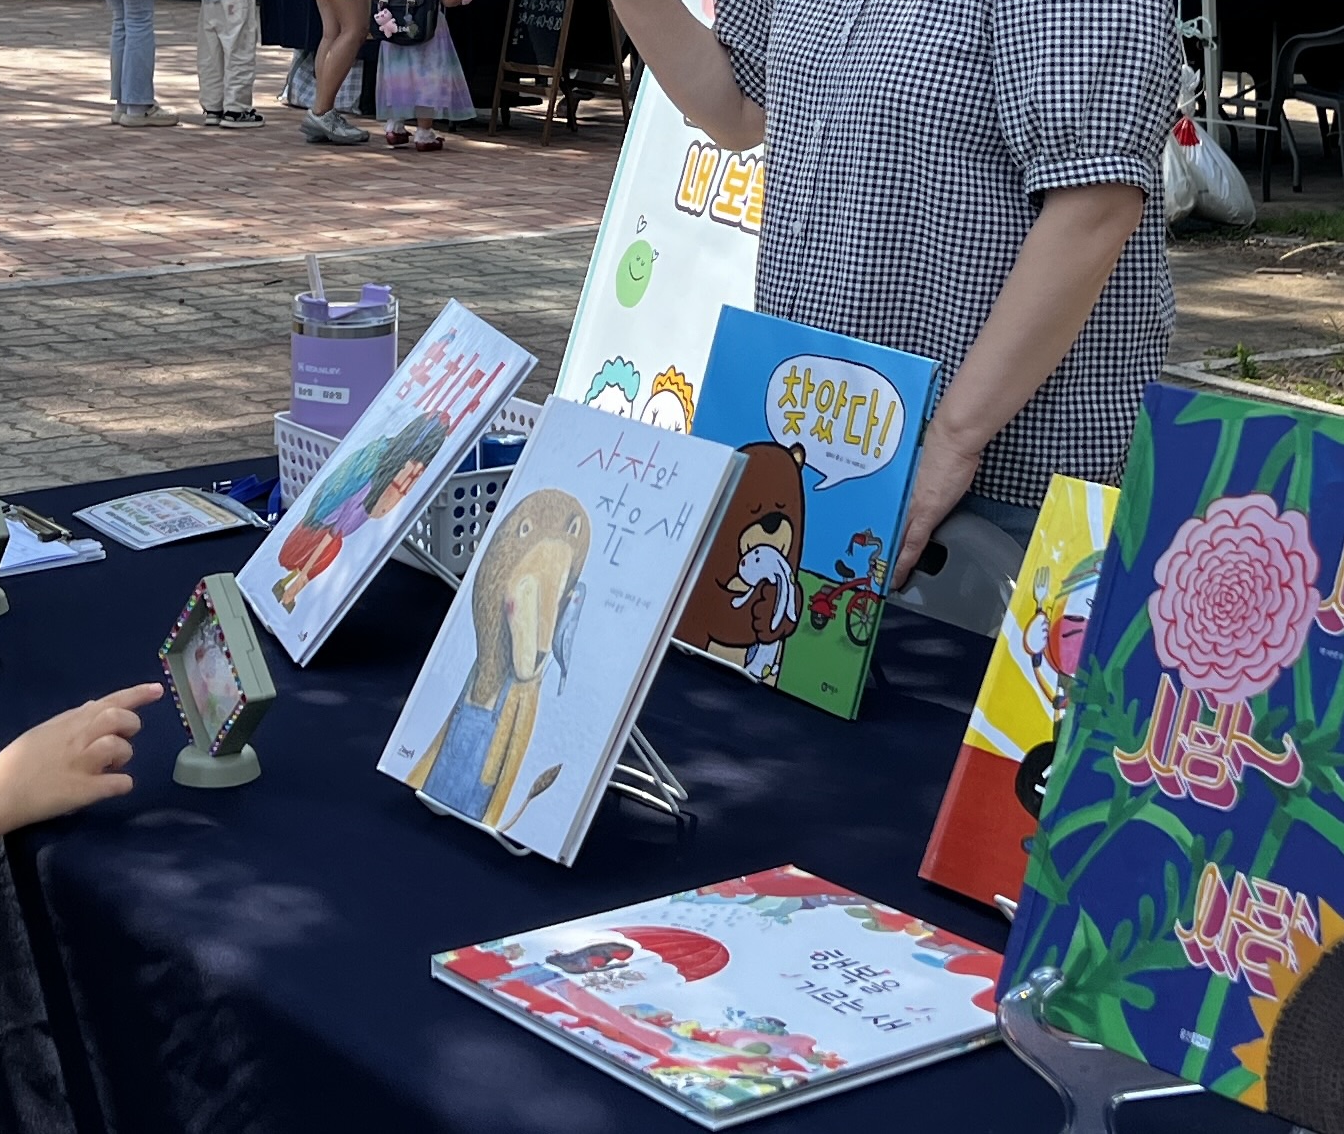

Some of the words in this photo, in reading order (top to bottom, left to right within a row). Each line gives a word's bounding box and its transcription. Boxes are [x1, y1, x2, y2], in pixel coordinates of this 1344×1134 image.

[677, 142, 719, 215] 내
[778, 365, 897, 458] 찾았다!
[577, 431, 678, 489] 사자와
[596, 483, 642, 566] 작은
[644, 502, 694, 541] 새
[810, 949, 900, 995] 행복을
[795, 980, 864, 1015] 기르는
[862, 1014, 912, 1032] 새
